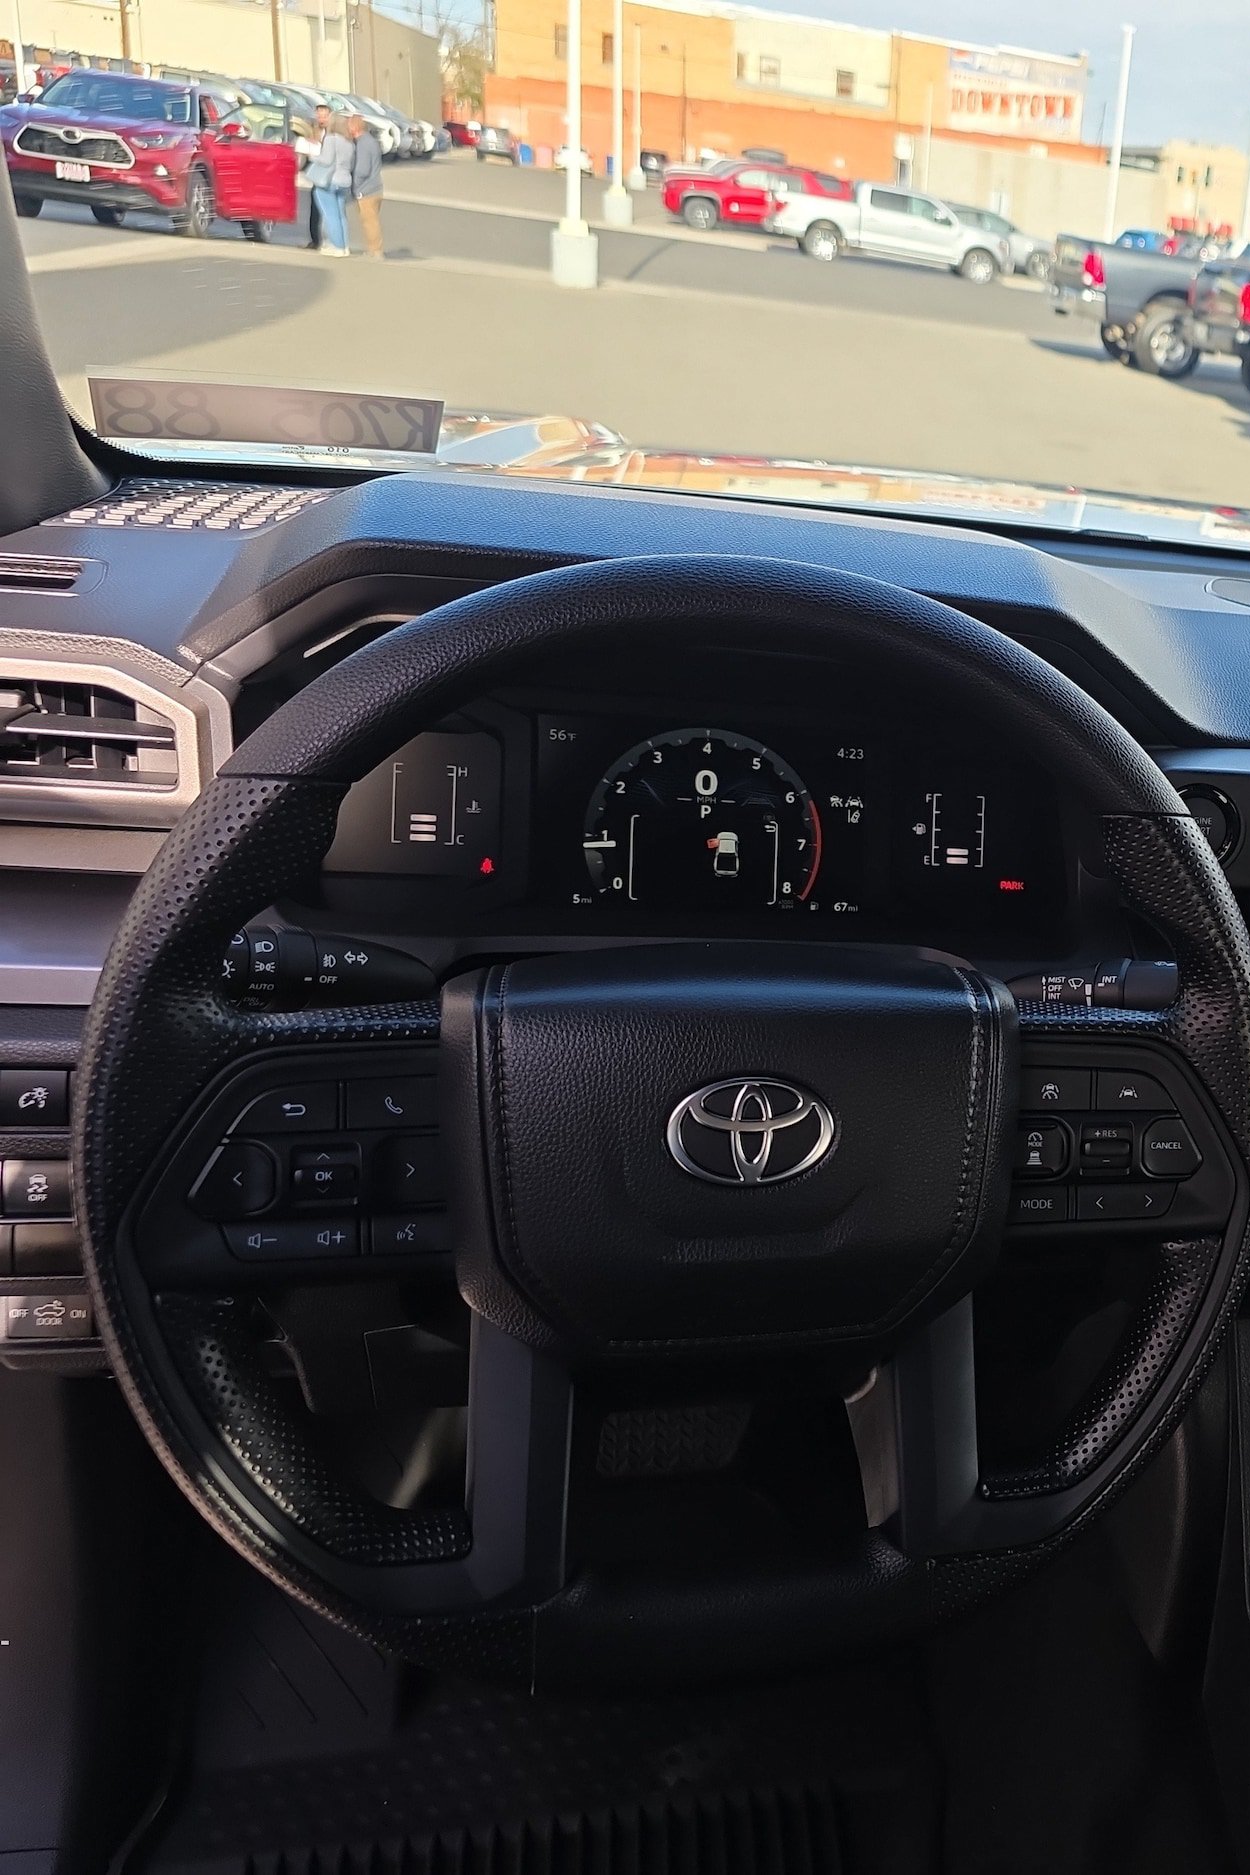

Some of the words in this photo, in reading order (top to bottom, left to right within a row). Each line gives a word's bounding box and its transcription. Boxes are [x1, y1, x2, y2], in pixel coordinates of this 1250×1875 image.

[702, 742, 713, 755] 4
[836, 748, 865, 760] 4:23
[652, 751, 663, 764] 3
[751, 757, 762, 770] 5
[458, 767, 468, 778] H
[615, 781, 626, 794] 2
[694, 769, 719, 796] 0
[696, 796, 717, 805] MPH
[785, 791, 796, 804] 6
[925, 793, 932, 803] F
[700, 804, 712, 819] P
[456, 834, 465, 845] C
[601, 829, 609, 842] 1
[796, 838, 807, 851] 7
[923, 855, 931, 865] E
[612, 877, 623, 890] 0
[782, 881, 792, 894] 8
[999, 880, 1025, 890] PARK
[318, 975, 339, 985] OFF
[1047, 976, 1067, 984] MIST
[1101, 975, 1118, 984] INT
[248, 983, 275, 991] AUTO
[1047, 984, 1063, 992] OFF
[1150, 1141, 1183, 1150] CANCEL
[315, 1171, 333, 1183] OK
[27, 1193, 48, 1202] OFF
[1020, 1199, 1054, 1209] MODE
[8, 1308, 30, 1319] OFF
[69, 1309, 87, 1319] ON
[35, 1317, 63, 1326] DOOR
